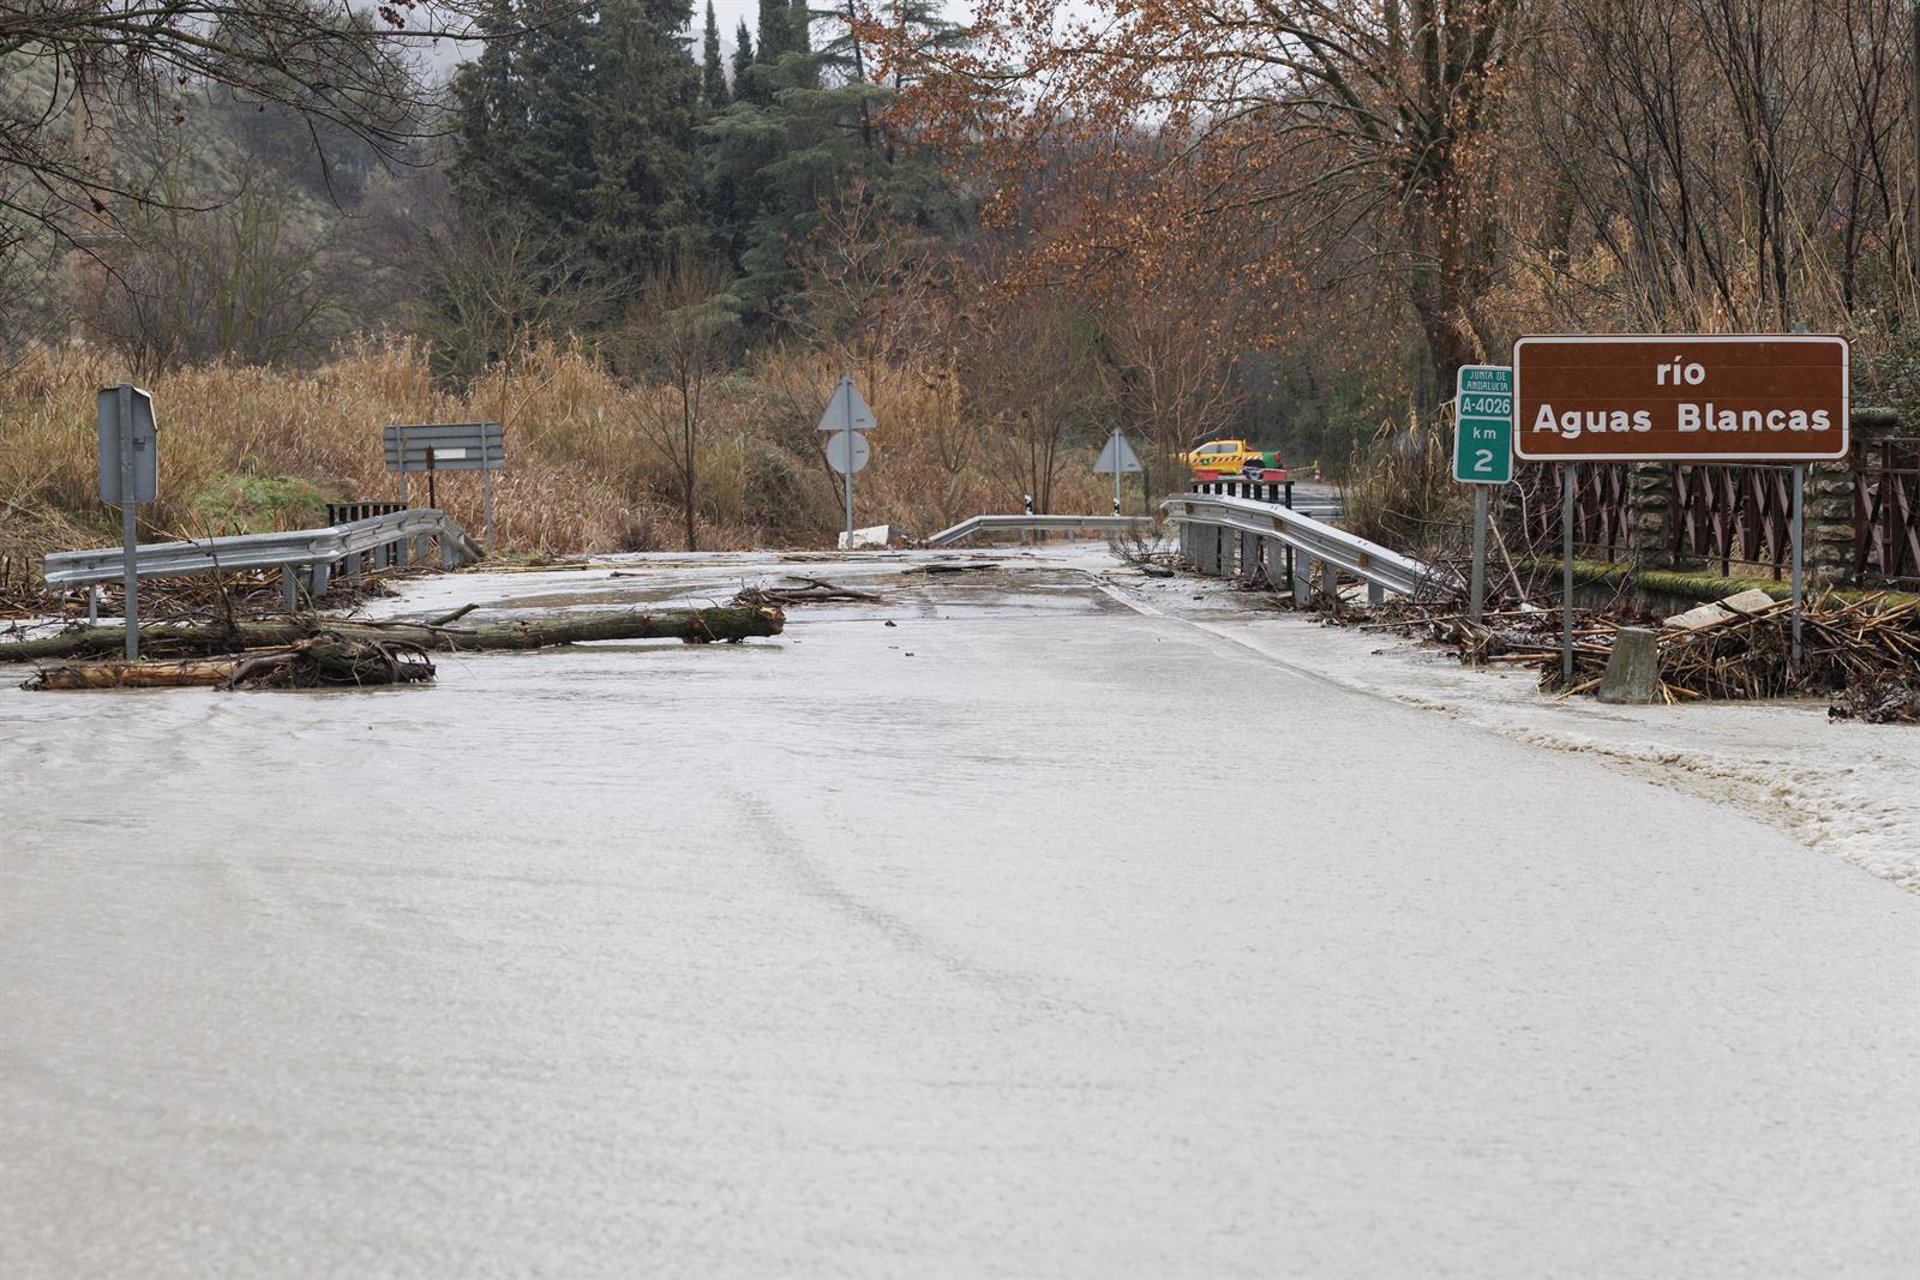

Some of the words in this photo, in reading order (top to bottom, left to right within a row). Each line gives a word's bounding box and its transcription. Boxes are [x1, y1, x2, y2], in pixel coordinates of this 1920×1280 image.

[1469, 371, 1494, 380] JUNTA
[1496, 371, 1507, 380] DE
[1656, 355, 1706, 386] río
[1462, 397, 1511, 414] A-4026
[1532, 403, 1652, 440] Aguas
[1677, 403, 1831, 433] Blancas
[1473, 427, 1496, 439] km
[1474, 449, 1493, 472] 2
